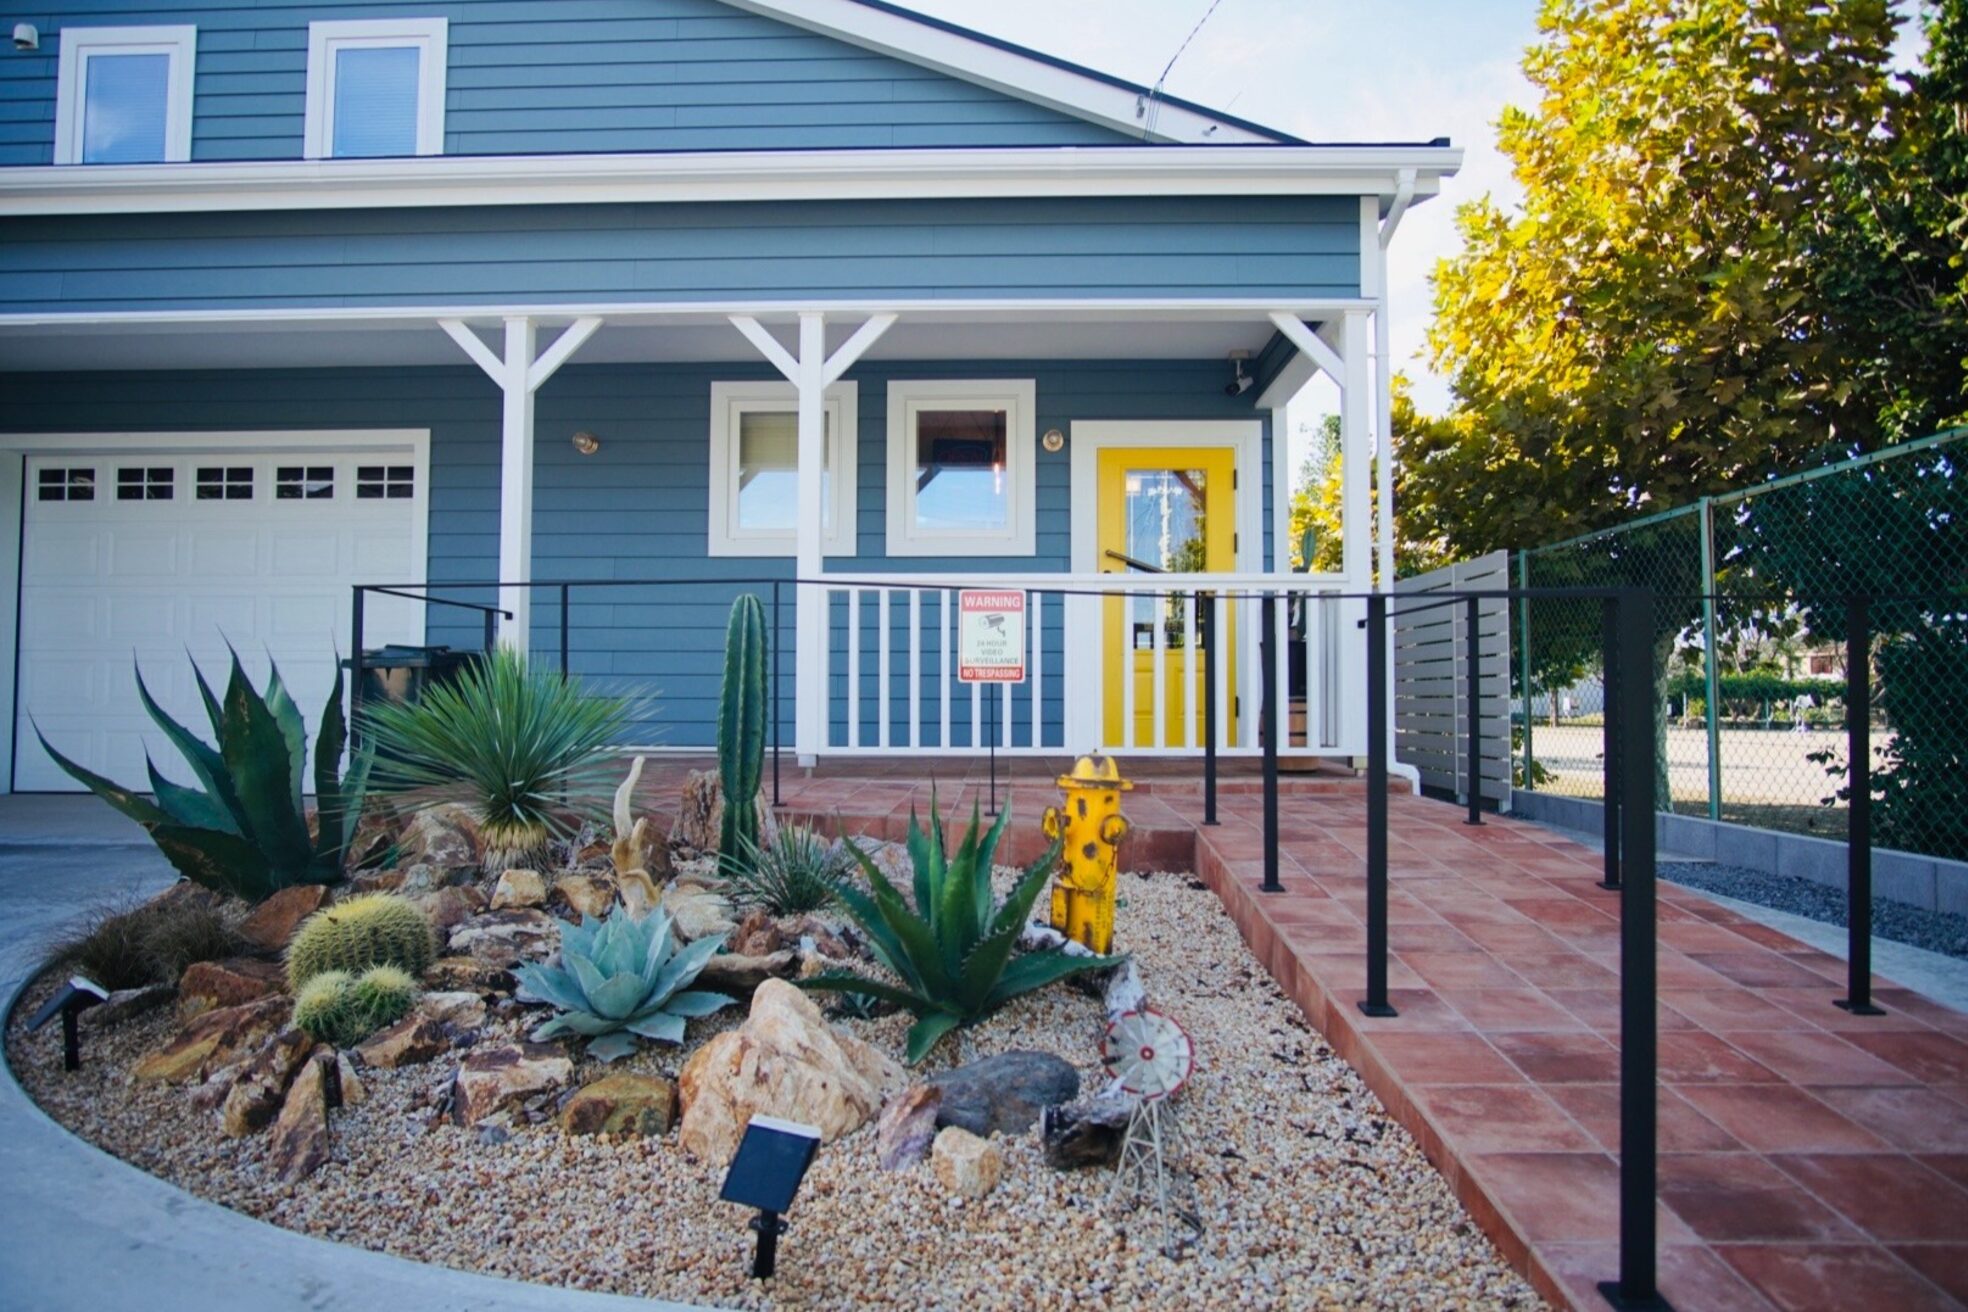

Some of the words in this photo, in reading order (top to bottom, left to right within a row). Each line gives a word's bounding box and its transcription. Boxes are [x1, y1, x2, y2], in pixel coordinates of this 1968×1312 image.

[964, 596, 1021, 607] WARNING
[963, 669, 974, 678] NO
[975, 669, 1020, 678] TRESPASSING
